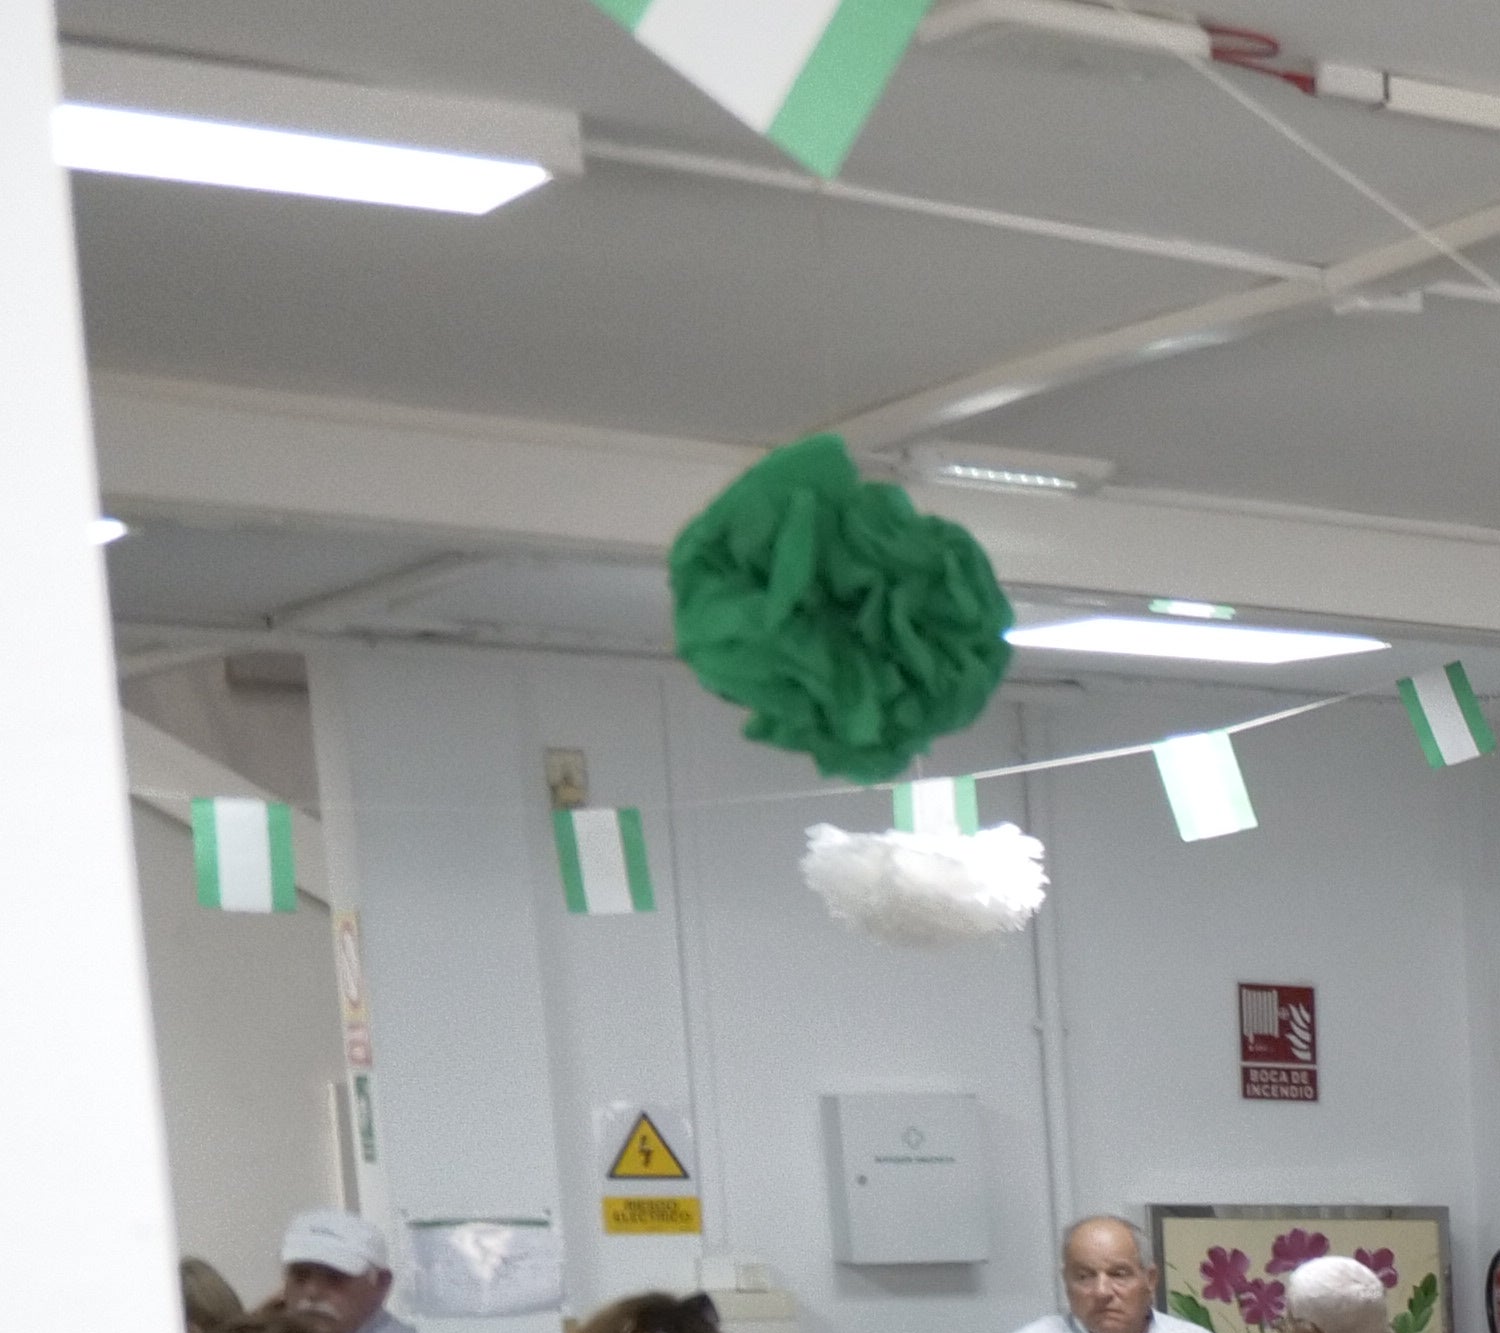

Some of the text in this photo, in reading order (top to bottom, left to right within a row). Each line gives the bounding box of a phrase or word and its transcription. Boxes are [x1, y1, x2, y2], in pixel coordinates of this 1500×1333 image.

[1249, 1069, 1309, 1084] BOCA DE
[1246, 1083, 1314, 1099] INCENDIO
